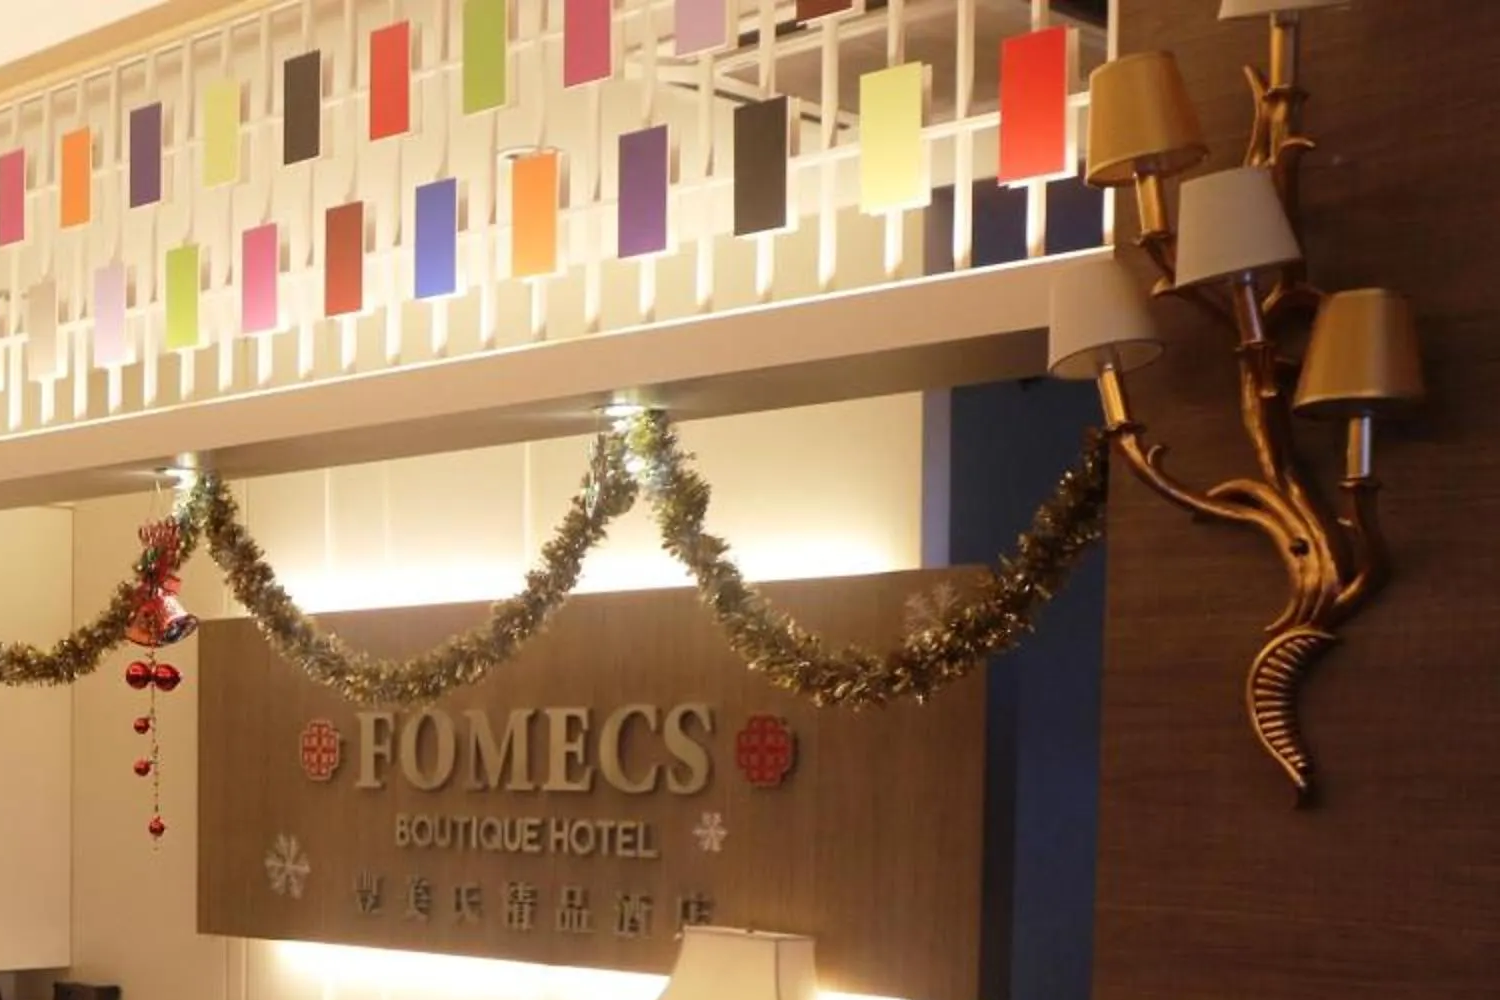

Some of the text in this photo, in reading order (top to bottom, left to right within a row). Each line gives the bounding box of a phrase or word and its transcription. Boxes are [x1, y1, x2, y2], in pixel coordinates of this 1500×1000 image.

[355, 704, 713, 795] FOMECS
[395, 814, 658, 858] BOUTIQUE HOTEL
